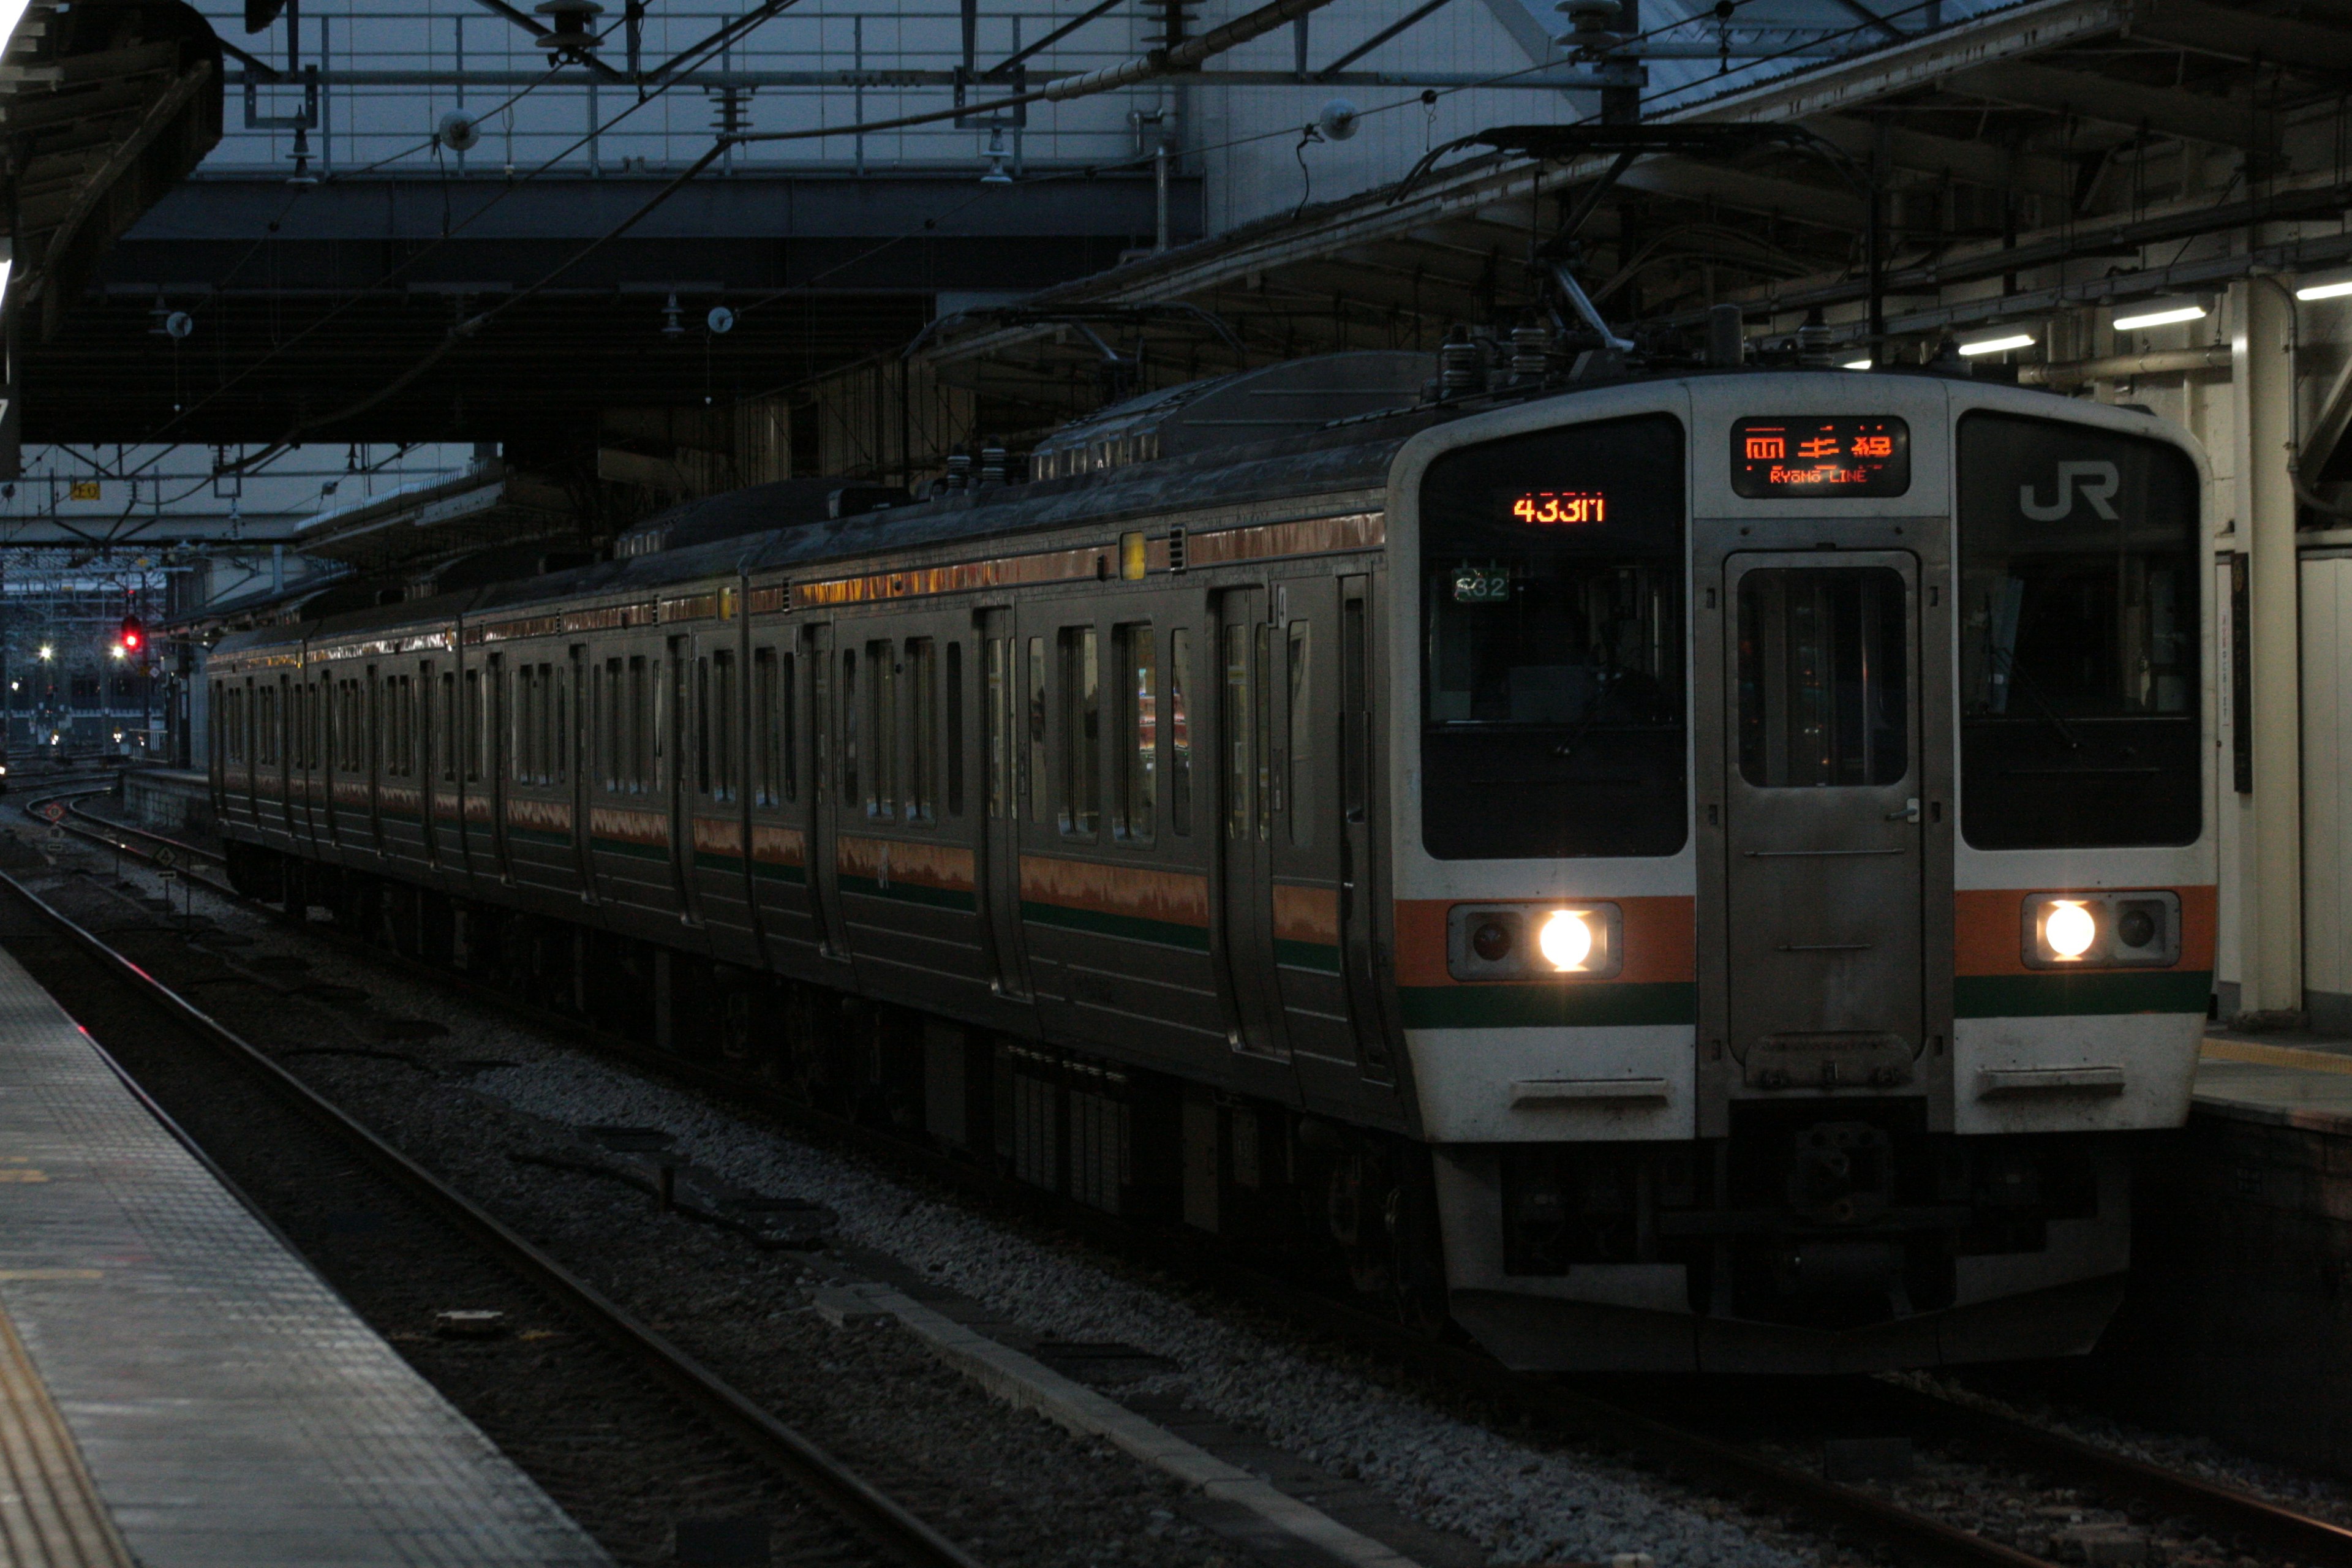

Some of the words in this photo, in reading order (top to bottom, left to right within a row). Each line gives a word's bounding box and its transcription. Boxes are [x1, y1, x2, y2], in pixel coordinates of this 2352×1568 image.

[1830, 469, 1868, 483] LINE
[2020, 461, 2120, 521] JR
[1513, 492, 1604, 522] 433M
[1454, 577, 1506, 597] A32
